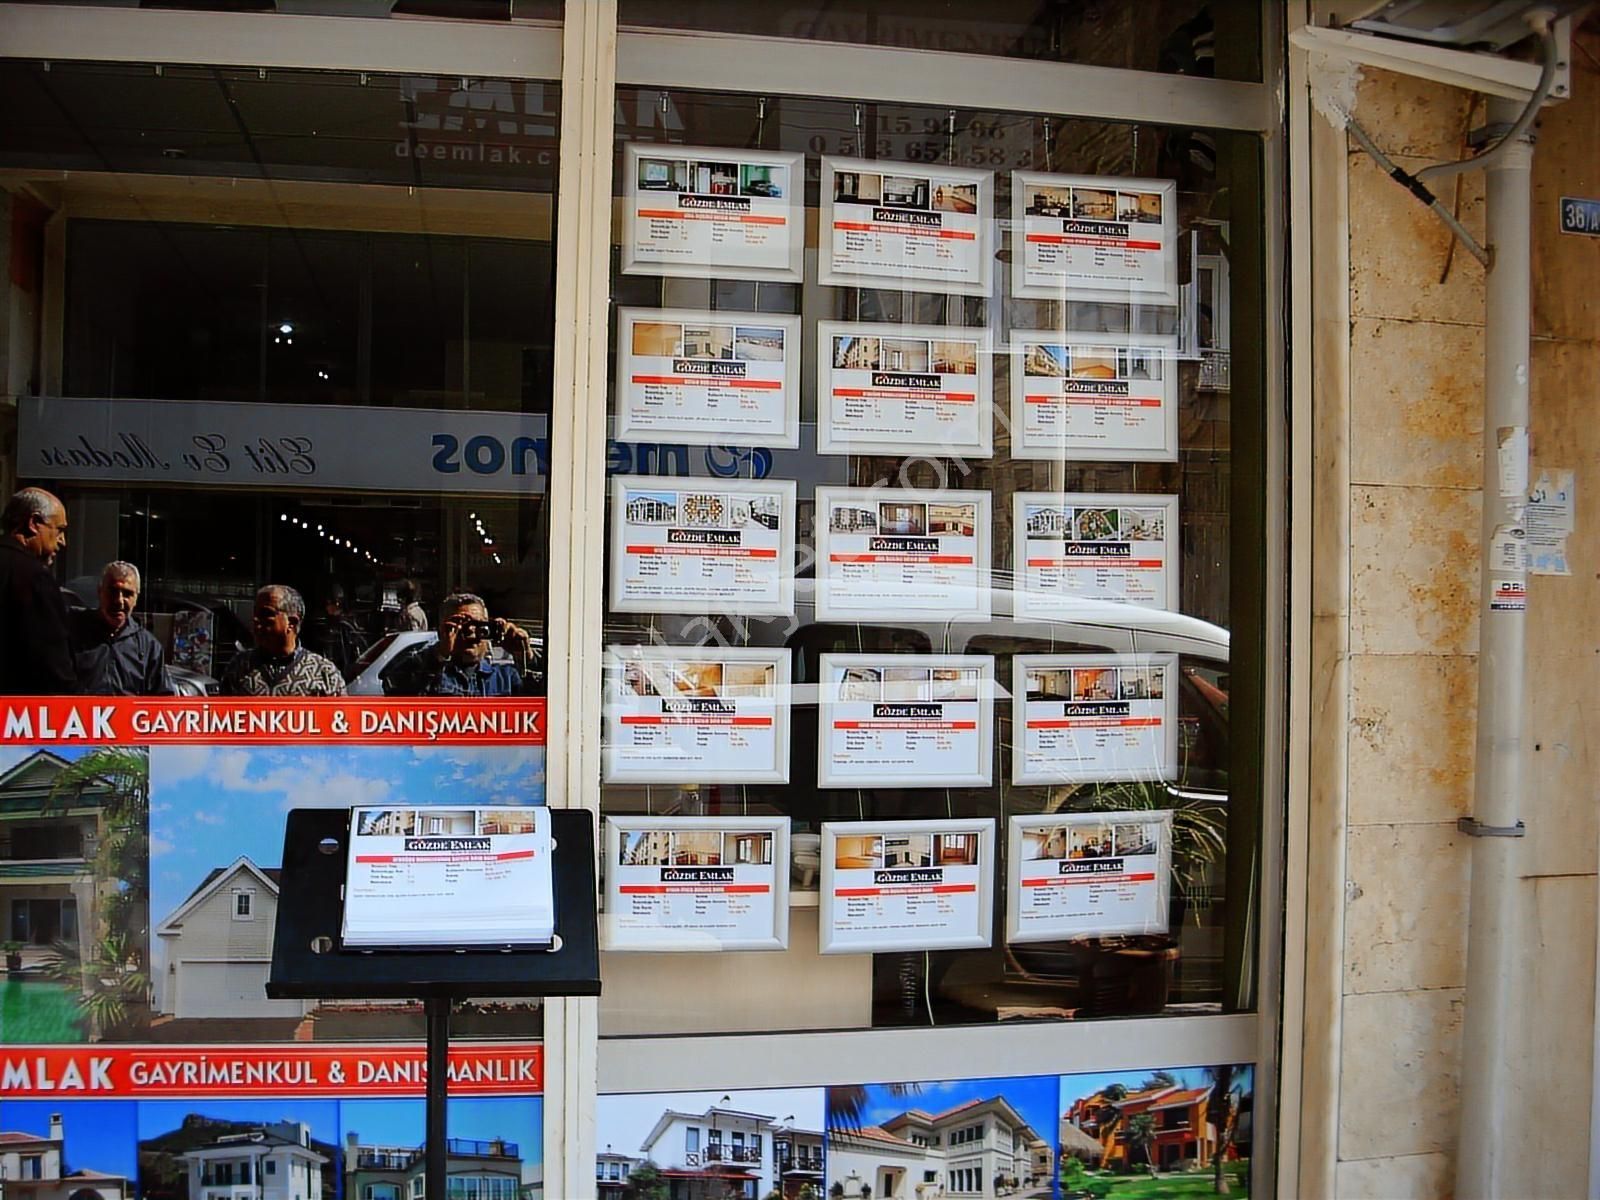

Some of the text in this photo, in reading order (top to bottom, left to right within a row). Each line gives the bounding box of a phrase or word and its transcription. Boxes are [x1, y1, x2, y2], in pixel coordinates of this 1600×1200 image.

[717, 200, 750, 210] EMLAK
[910, 214, 941, 225] EMLAK
[1098, 226, 1128, 235] EMLAK
[712, 364, 745, 375] EMLAK
[909, 377, 941, 387] EMLAK
[1098, 384, 1128, 393] EMLAK
[707, 533, 740, 543] EMLAK
[906, 541, 938, 551] EMLAK
[1100, 545, 1130, 555] EMLAK
[910, 707, 942, 716] EMLAK
[1100, 704, 1130, 714] EMLAK
[3, 702, 540, 742] MLAK GAYRİMENKUL & DANIŞMANLIK
[449, 840, 491, 851] EMLAK
[1093, 861, 1123, 871] EMLAK
[700, 871, 734, 880] EMLAK
[910, 872, 942, 882] EMLAK
[2, 1057, 115, 1092] MLAK
[129, 1055, 319, 1088] GAYRİMENKUL
[329, 1061, 346, 1084] &
